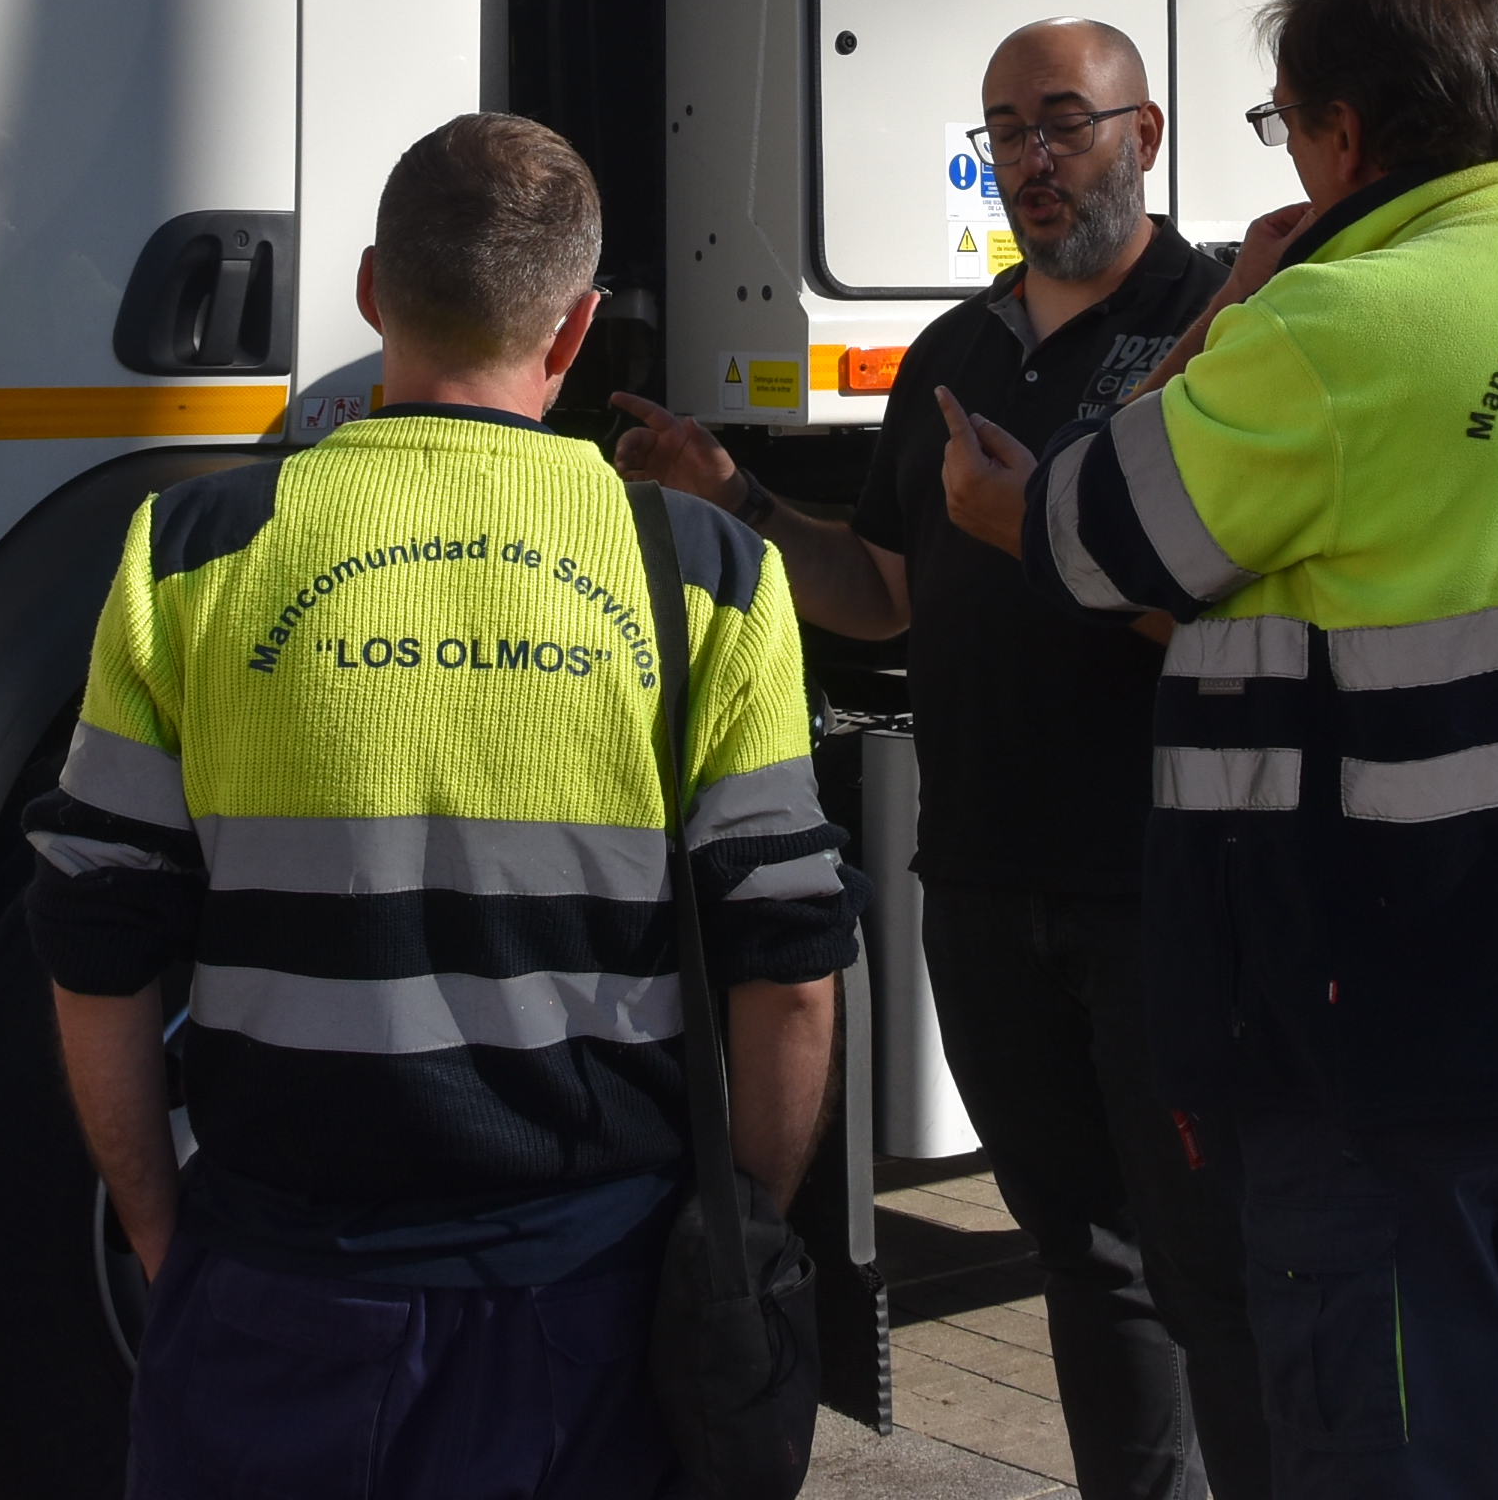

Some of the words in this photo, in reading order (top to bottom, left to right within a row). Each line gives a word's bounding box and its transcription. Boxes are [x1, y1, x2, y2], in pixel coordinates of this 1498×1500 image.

[1102, 334, 1180, 370] 1928
[249, 534, 487, 675] Mancomunidad
[502, 539, 542, 569] de
[553, 557, 657, 690] Servicios
